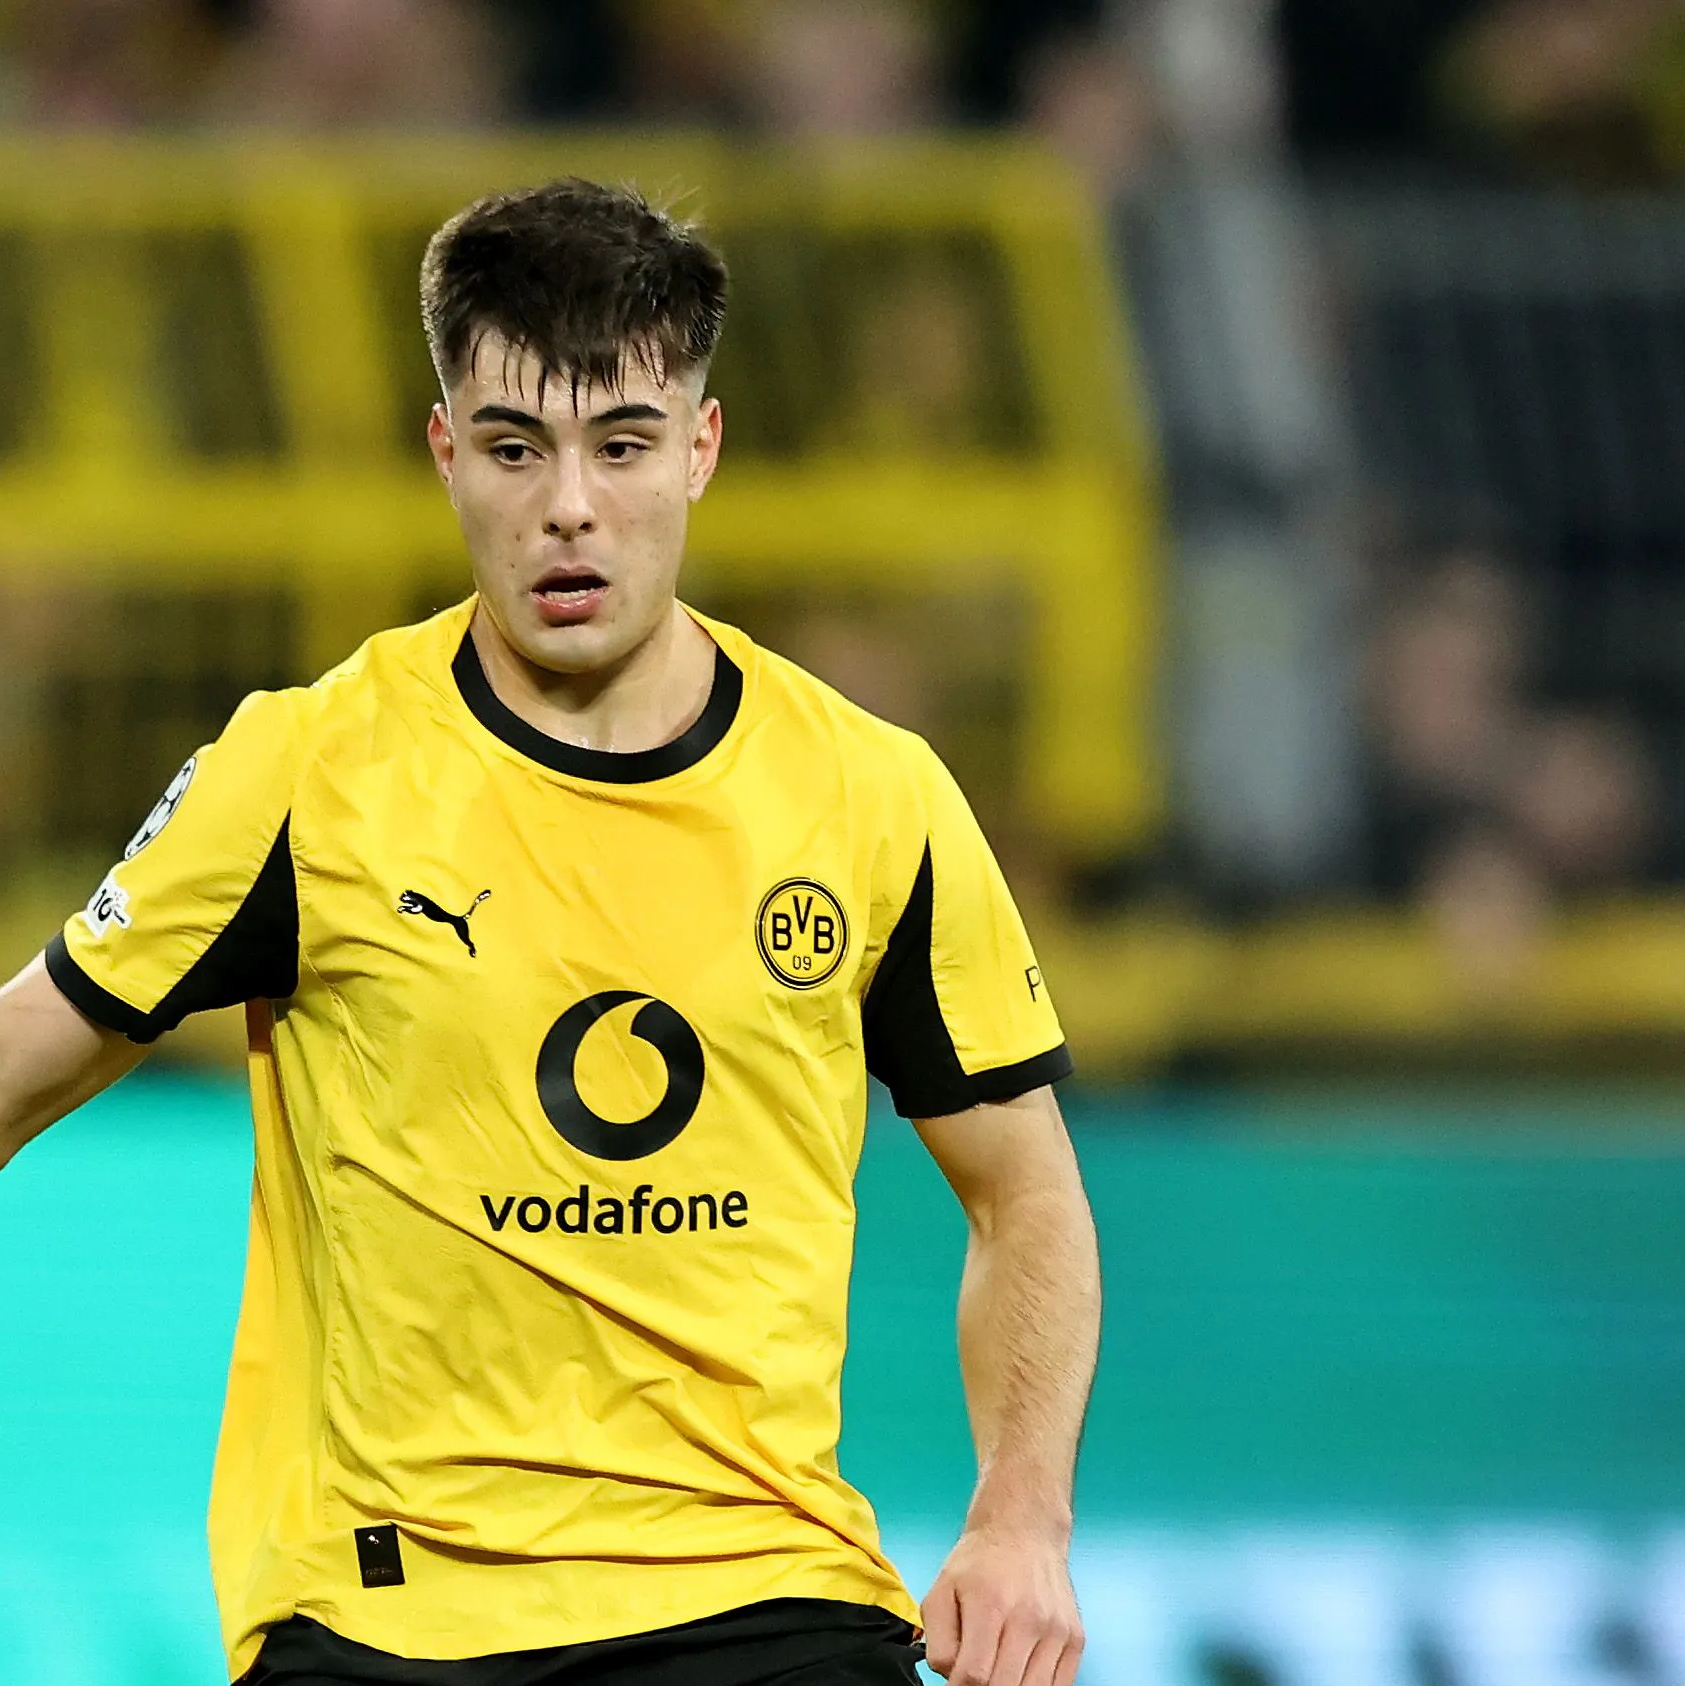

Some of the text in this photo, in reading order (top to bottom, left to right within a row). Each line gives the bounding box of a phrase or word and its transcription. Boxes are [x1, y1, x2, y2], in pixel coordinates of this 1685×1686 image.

[771, 895, 835, 954] BVB
[792, 955, 812, 971] 09
[479, 1184, 749, 1234] vodafone
